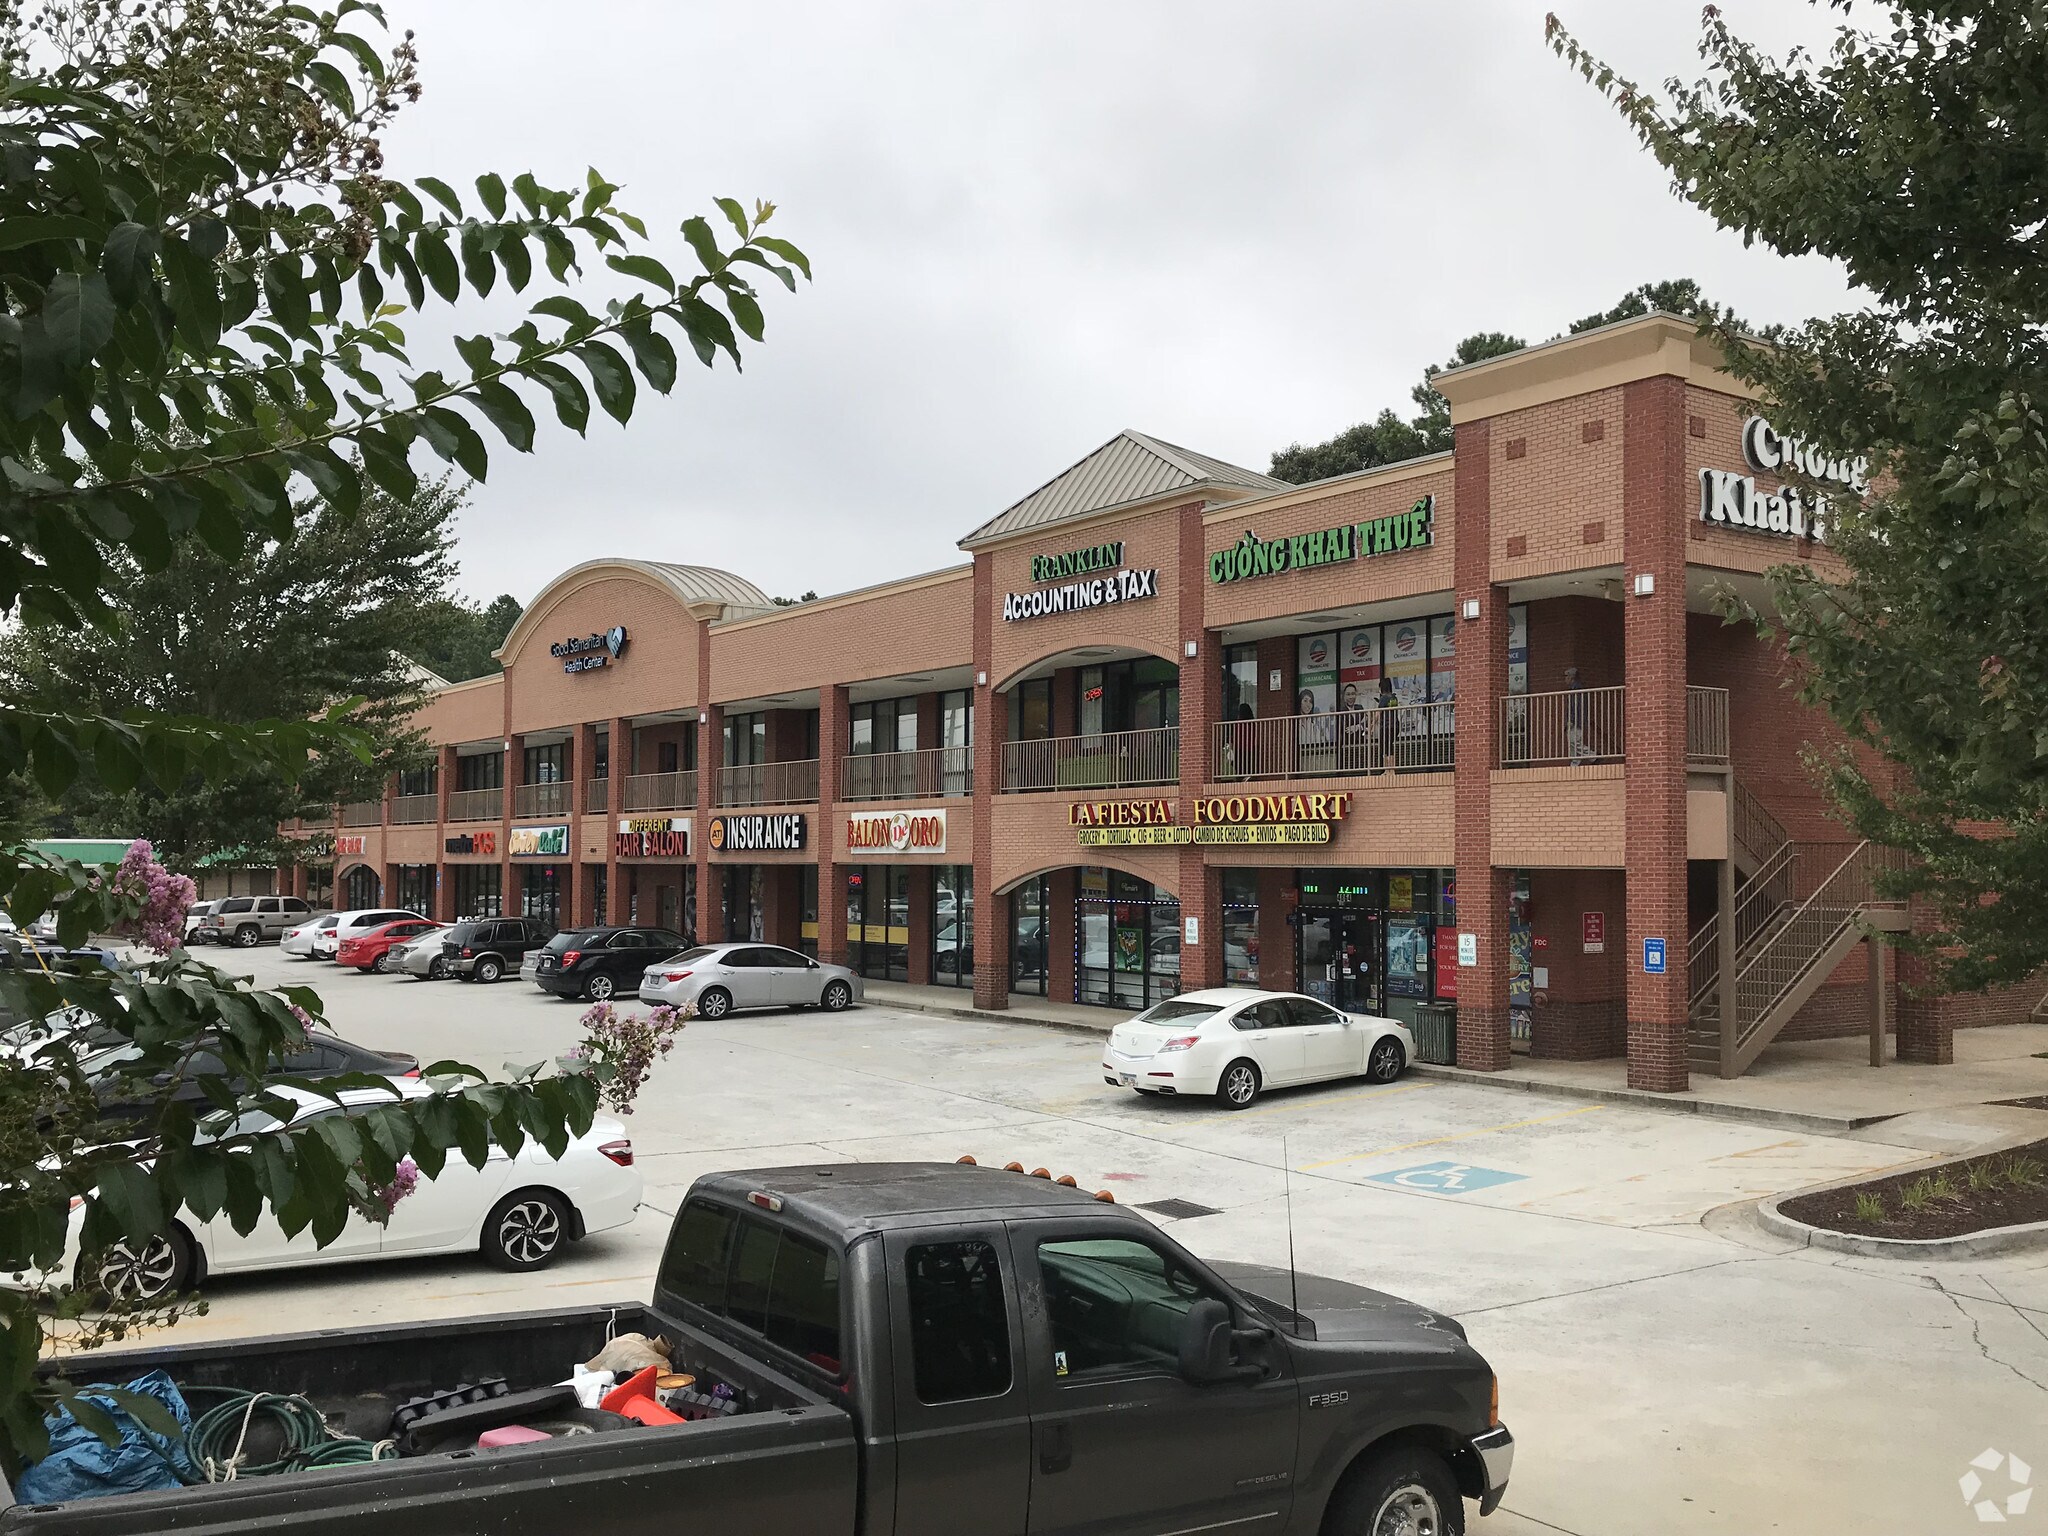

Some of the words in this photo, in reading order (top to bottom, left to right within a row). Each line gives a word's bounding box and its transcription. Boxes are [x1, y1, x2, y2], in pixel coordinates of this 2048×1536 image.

[1290, 525, 1351, 568] KHAI
[1031, 542, 1120, 582] FRANKLIN
[1003, 579, 1102, 621] ACCOUNTING
[1105, 577, 1117, 603] &
[1118, 569, 1152, 600] TAX
[552, 641, 569, 657] Good
[570, 634, 604, 654] Samaritan
[564, 659, 583, 673] Health
[583, 656, 604, 670] Center
[1068, 804, 1093, 826] LA
[1097, 800, 1170, 825] FIESTA
[1193, 793, 1348, 823] FOODMART
[629, 819, 669, 832] DIFFERENT
[727, 815, 800, 849] INSURANCE
[847, 818, 891, 847] BALON
[911, 816, 939, 847] ORO
[1079, 830, 1101, 845] GROCERY
[1106, 829, 1131, 844] TORTILLAS
[1153, 828, 1166, 843] BEER
[1173, 827, 1191, 843] LOTTO
[1195, 827, 1215, 843] CAMBIO
[1216, 827, 1224, 842] DE
[1225, 826, 1249, 842] CHEQUES
[1256, 826, 1277, 842] ENVIOS
[1284, 825, 1301, 842] PAGO
[1301, 825, 1310, 842] DE
[1311, 825, 1327, 842] BILLS
[615, 832, 640, 857] HAIR
[645, 831, 684, 856] SALON
[1464, 937, 1471, 947] 15
